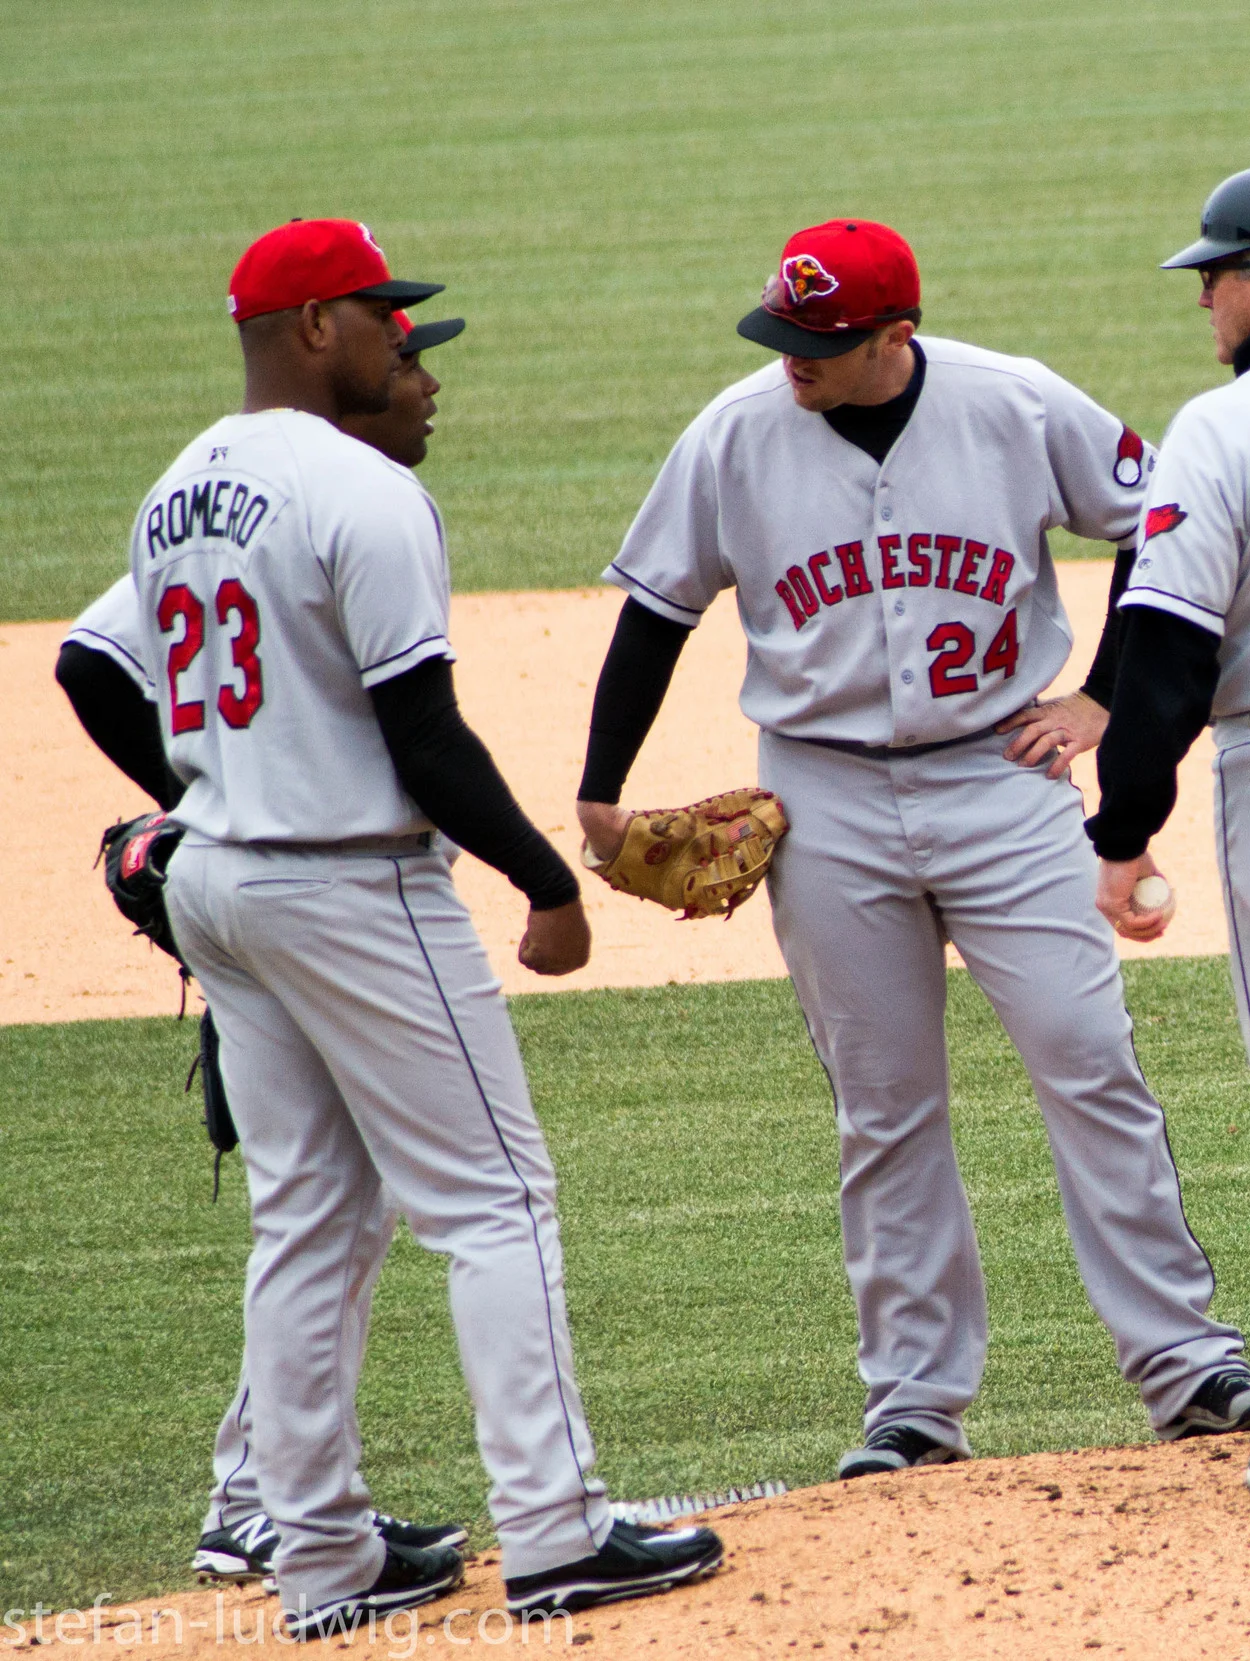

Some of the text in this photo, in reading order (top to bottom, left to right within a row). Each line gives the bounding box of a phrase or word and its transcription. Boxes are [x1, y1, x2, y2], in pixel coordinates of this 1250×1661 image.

[146, 480, 269, 559] ROMERO
[774, 533, 1016, 632] ROCHESTER
[156, 578, 264, 737] 23
[925, 606, 1021, 699] 24
